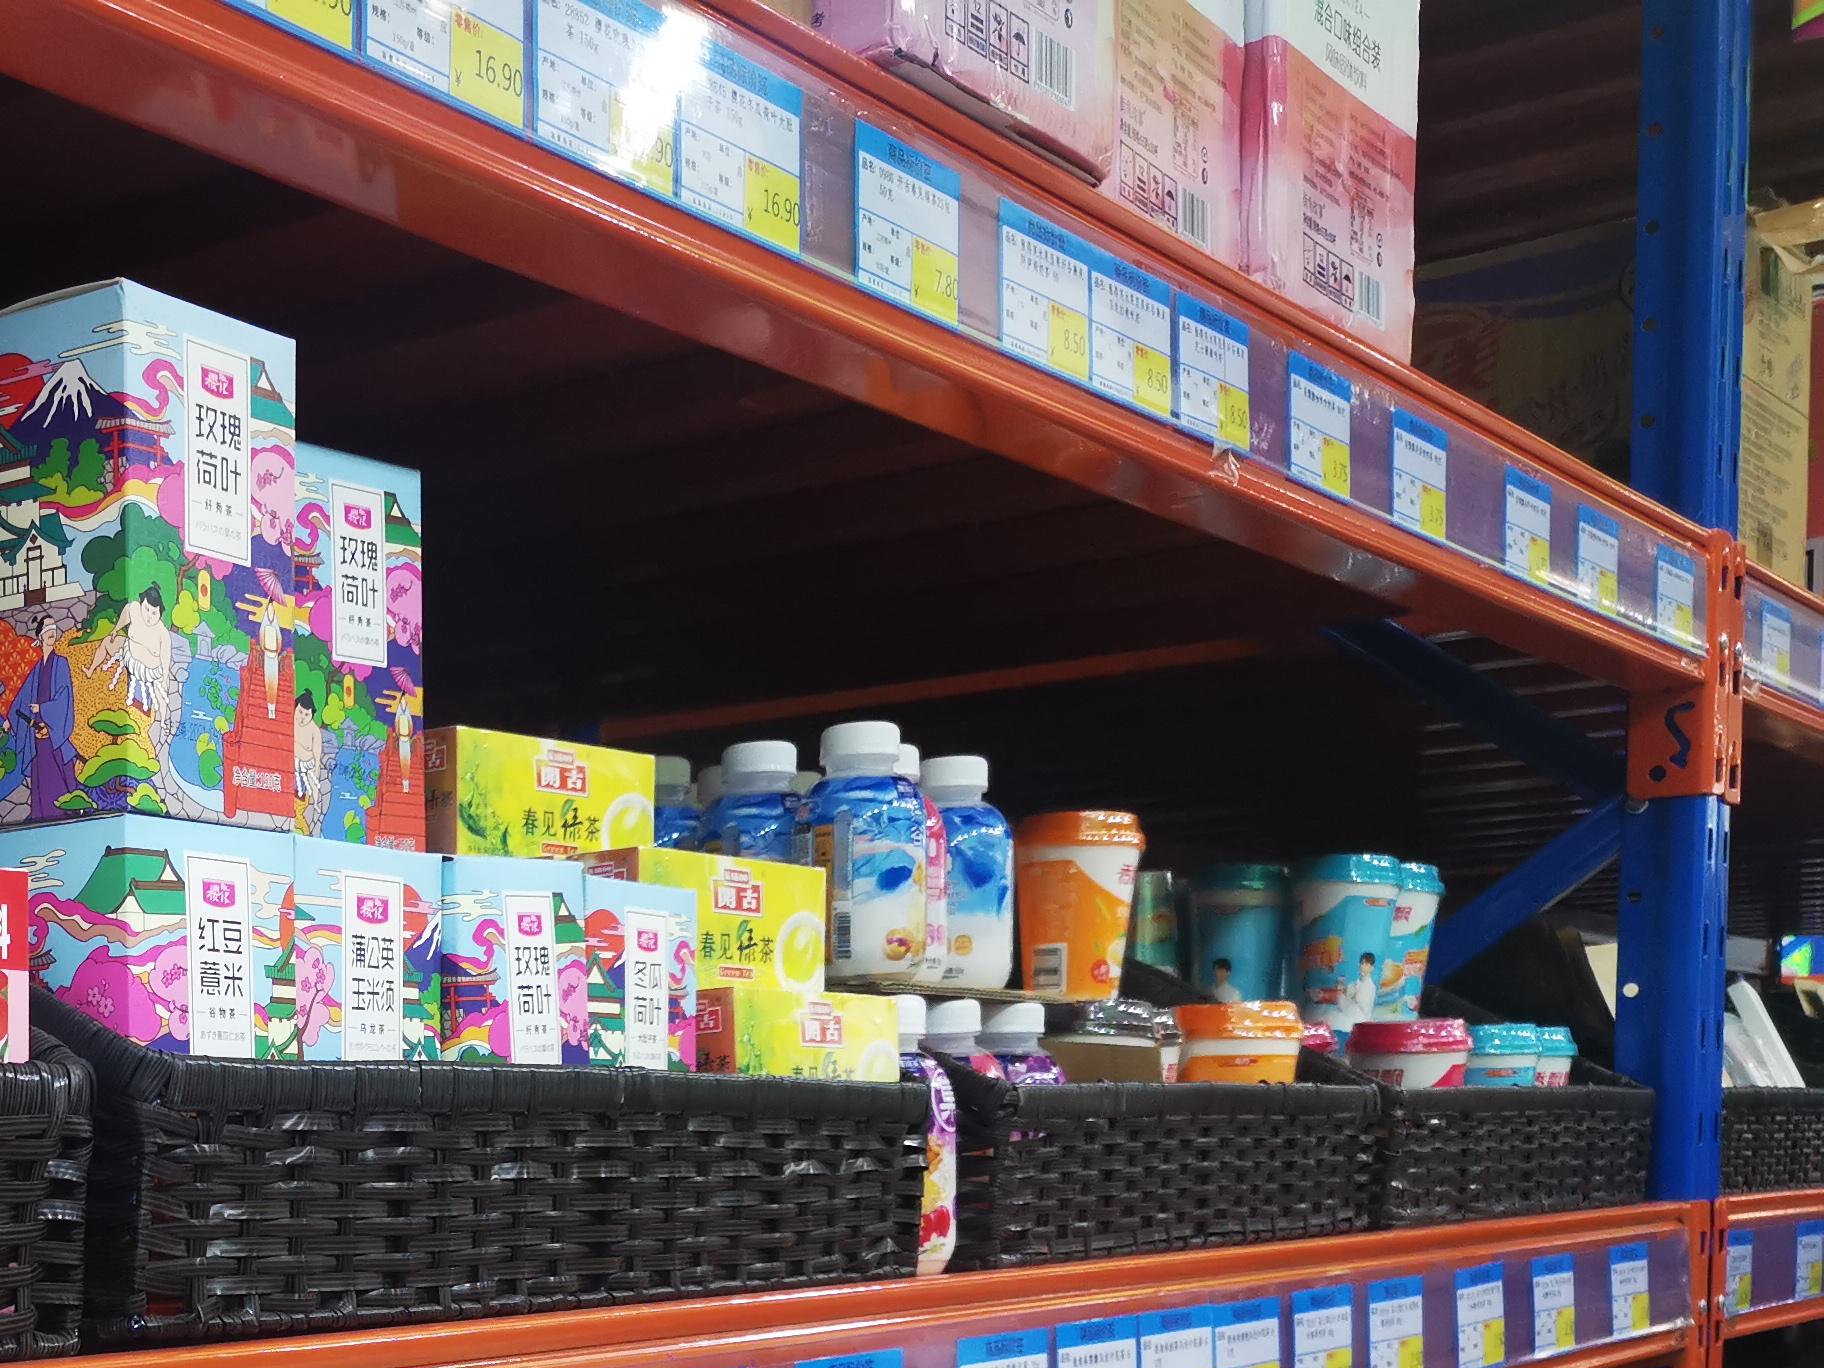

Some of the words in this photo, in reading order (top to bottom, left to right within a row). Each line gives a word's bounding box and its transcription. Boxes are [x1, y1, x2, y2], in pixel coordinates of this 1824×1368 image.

[475, 49, 522, 97] 16.90
[763, 189, 801, 227] 16.90
[935, 269, 958, 300] 7.80
[1063, 329, 1085, 357] 8.50
[1147, 368, 1168, 395] 8.50
[195, 403, 241, 451] 玫瑰
[196, 450, 241, 495] 荷叶
[340, 535, 378, 571] 玫瑰
[341, 574, 378, 610] 荷叶
[522, 807, 600, 841] 春见绿茶
[198, 916, 242, 955] 红豆
[352, 934, 394, 970] 蒲公英
[700, 927, 774, 963] 春见绿茶
[200, 961, 244, 997] 薏米
[515, 946, 550, 976] 玫瑰
[634, 960, 662, 990] 冬瓜
[209, 1007, 236, 1019] 谷物茶
[352, 977, 394, 1013] 玉米须
[518, 984, 552, 1015] 荷叶
[634, 996, 662, 1025] 荷叶
[360, 1023, 385, 1036] 乌龙茶
